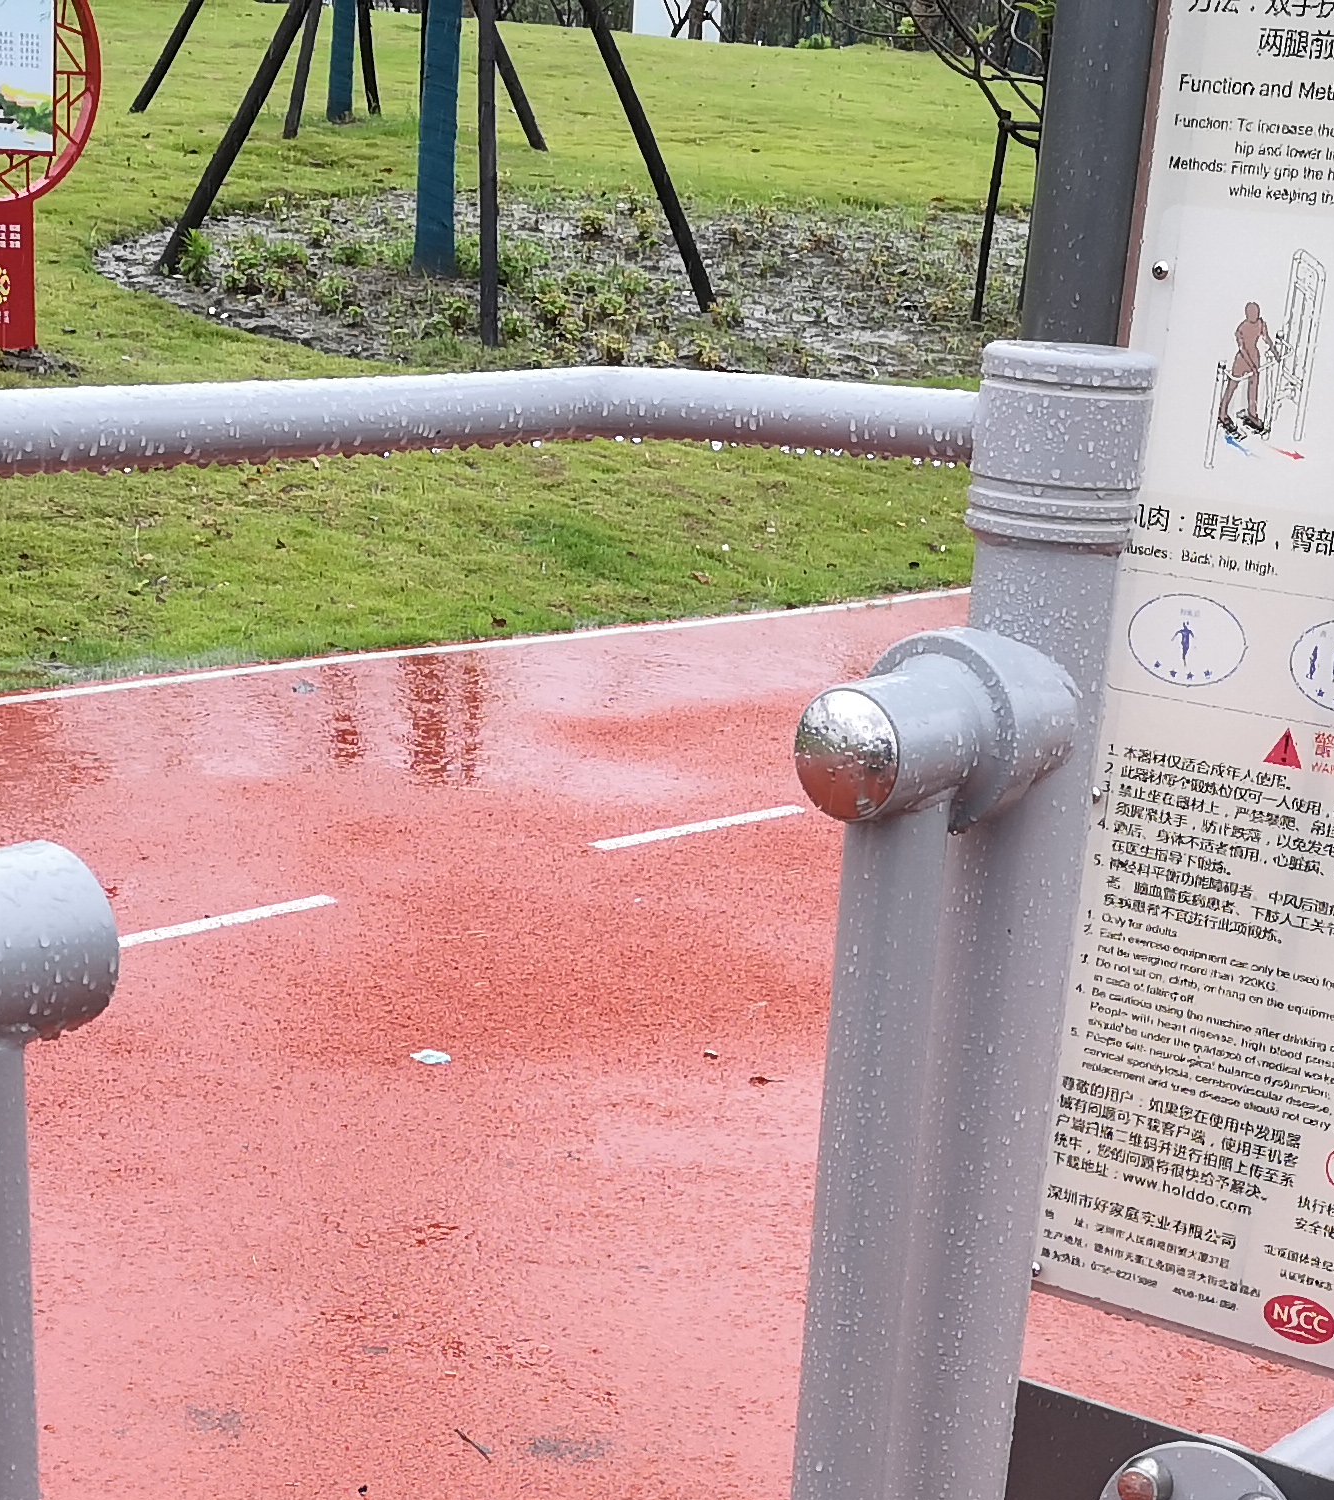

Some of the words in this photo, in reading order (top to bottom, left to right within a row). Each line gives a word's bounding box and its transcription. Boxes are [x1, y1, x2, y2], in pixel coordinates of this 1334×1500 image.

[1178, 73, 1255, 95] Function
[1258, 80, 1293, 98] and
[1257, 119, 1313, 136] increase
[1234, 140, 1254, 158] hip
[1257, 142, 1283, 157] and
[1285, 144, 1322, 160] lower
[1168, 155, 1226, 173] Methods:
[1230, 160, 1271, 179] Firmly
[1273, 163, 1298, 181] grip
[1302, 165, 1323, 180] the
[1228, 183, 1261, 198] while
[1265, 185, 1317, 205] keeping
[1244, 559, 1277, 576] thigh.
[1127, 918, 1143, 929] for
[1250, 963, 1274, 977] only
[1275, 967, 1290, 979] be
[1095, 956, 1111, 969] Do
[1113, 963, 1130, 974] not
[1248, 995, 1263, 1004] on
[1266, 997, 1284, 1009] the
[1131, 1013, 1153, 1025] with
[1240, 1037, 1265, 1052] high
[1269, 1044, 1302, 1060] blood
[1154, 1003, 1183, 1019] using
[1186, 1008, 1203, 1021] the
[1282, 1033, 1326, 1052] drinking
[1140, 1030, 1171, 1044] under
[1173, 1037, 1190, 1049] the
[1281, 1111, 1299, 1121] not
[1047, 1184, 1235, 1249] 深圳市好家庭实业有限公司
[1272, 1300, 1330, 1334] NSCC
